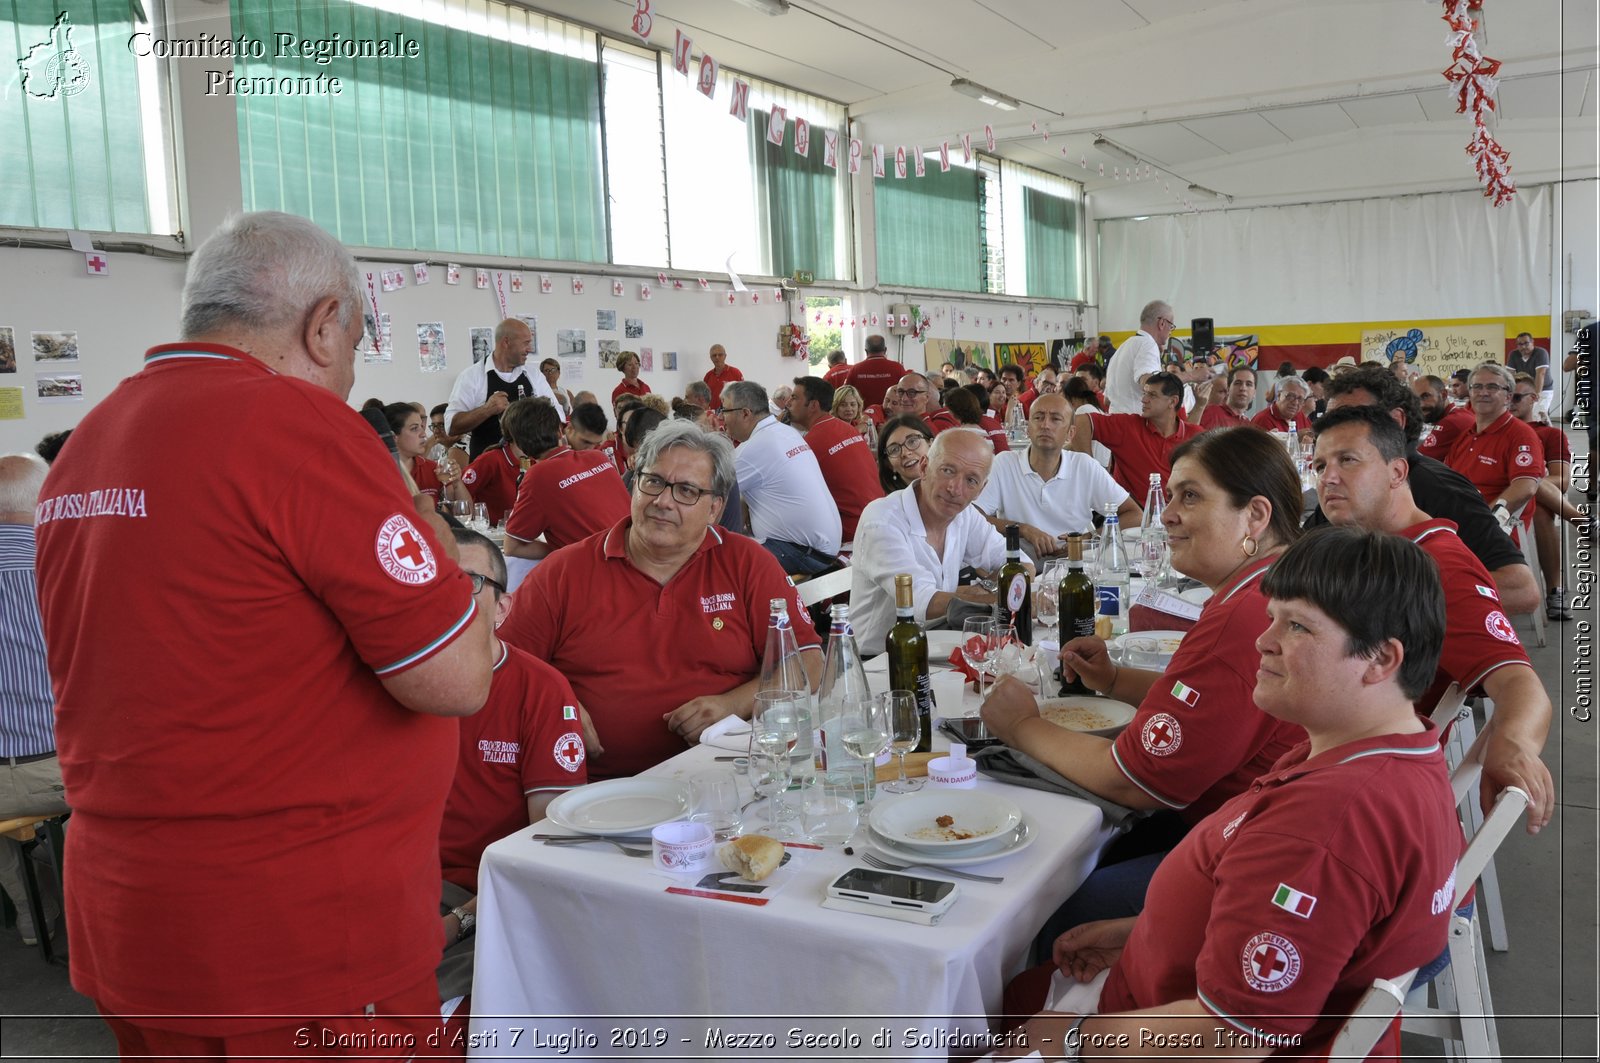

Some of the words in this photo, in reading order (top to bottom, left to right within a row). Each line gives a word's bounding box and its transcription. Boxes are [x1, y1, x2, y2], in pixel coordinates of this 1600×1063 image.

[559, 475, 579, 489] CROCE
[86, 488, 147, 517] ITALIANA
[716, 593, 736, 602] ROSSA
[703, 602, 732, 612] ITALIANA
[478, 740, 501, 753] CROCE
[483, 750, 516, 763] ITALIANA
[936, 776, 949, 784] SAN
